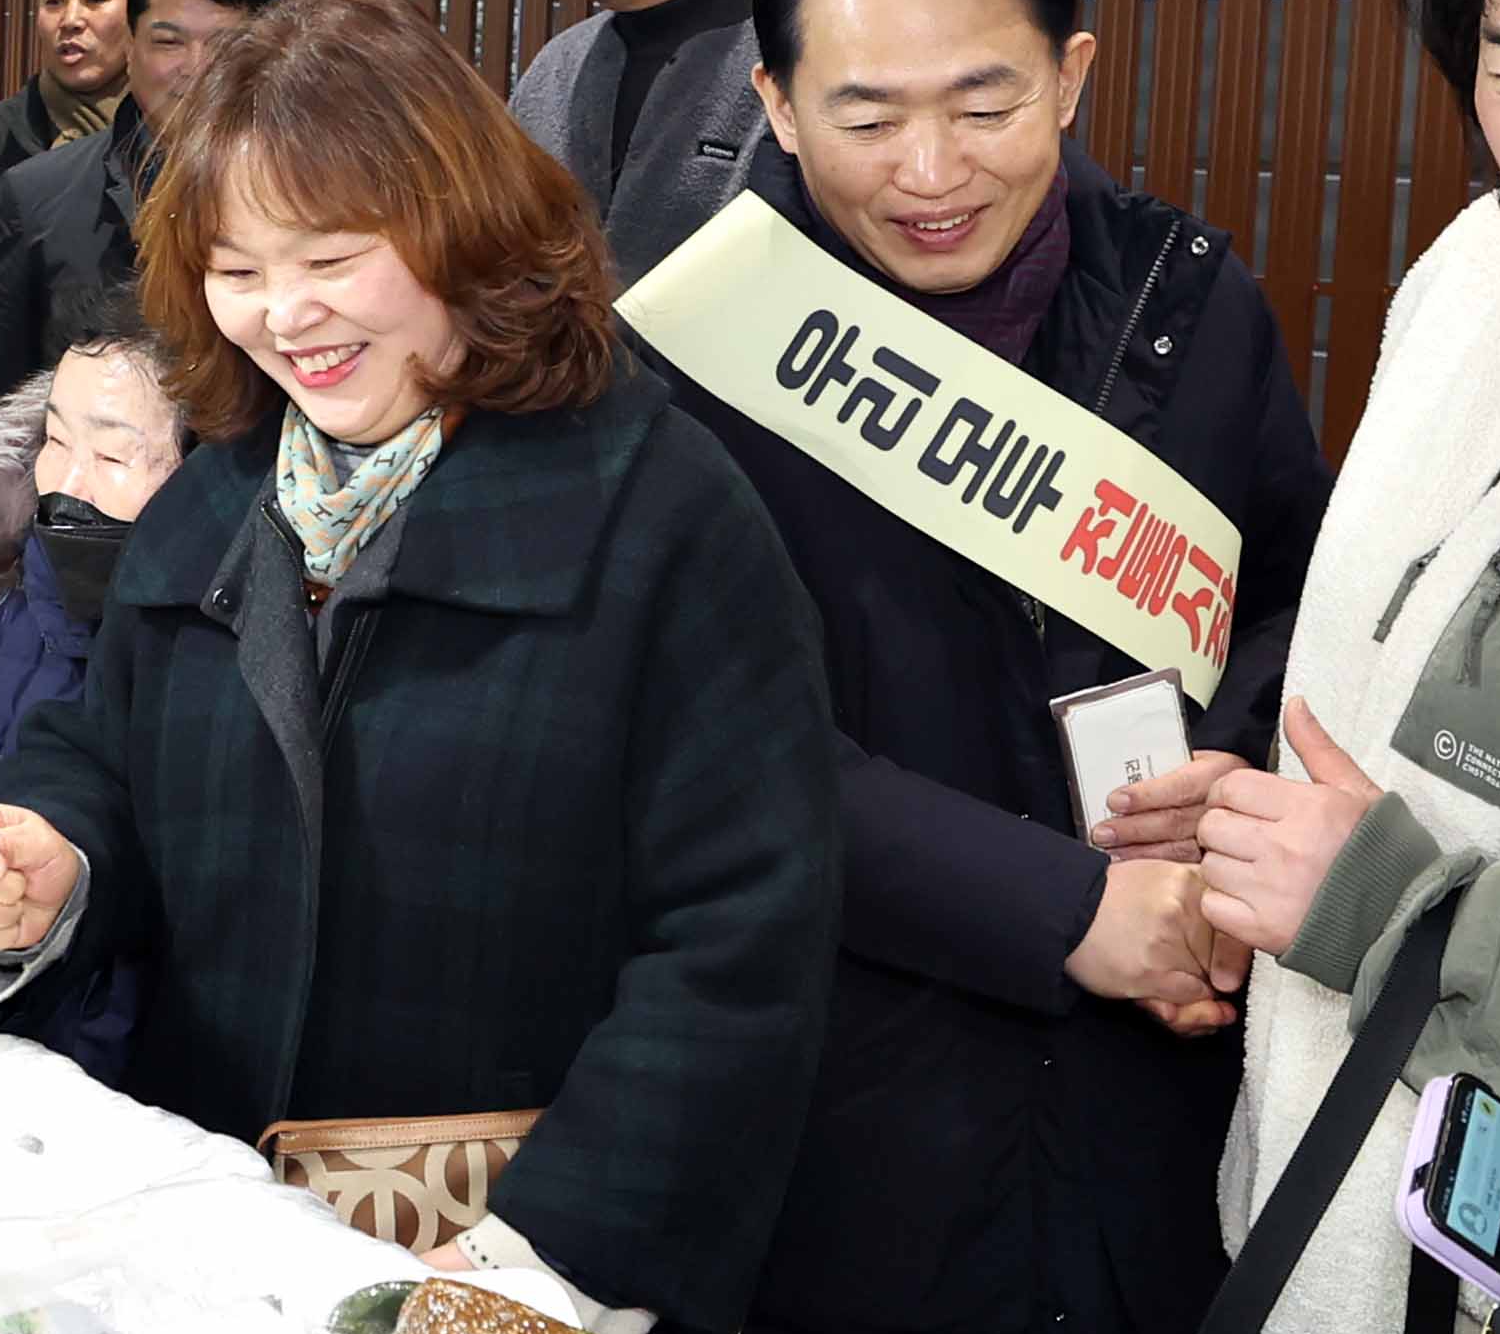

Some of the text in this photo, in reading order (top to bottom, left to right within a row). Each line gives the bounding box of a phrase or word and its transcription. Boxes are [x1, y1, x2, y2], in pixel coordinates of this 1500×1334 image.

[775, 308, 942, 452] 우리
[916, 396, 1067, 534] 모두
[1468, 743, 1485, 758] THE
